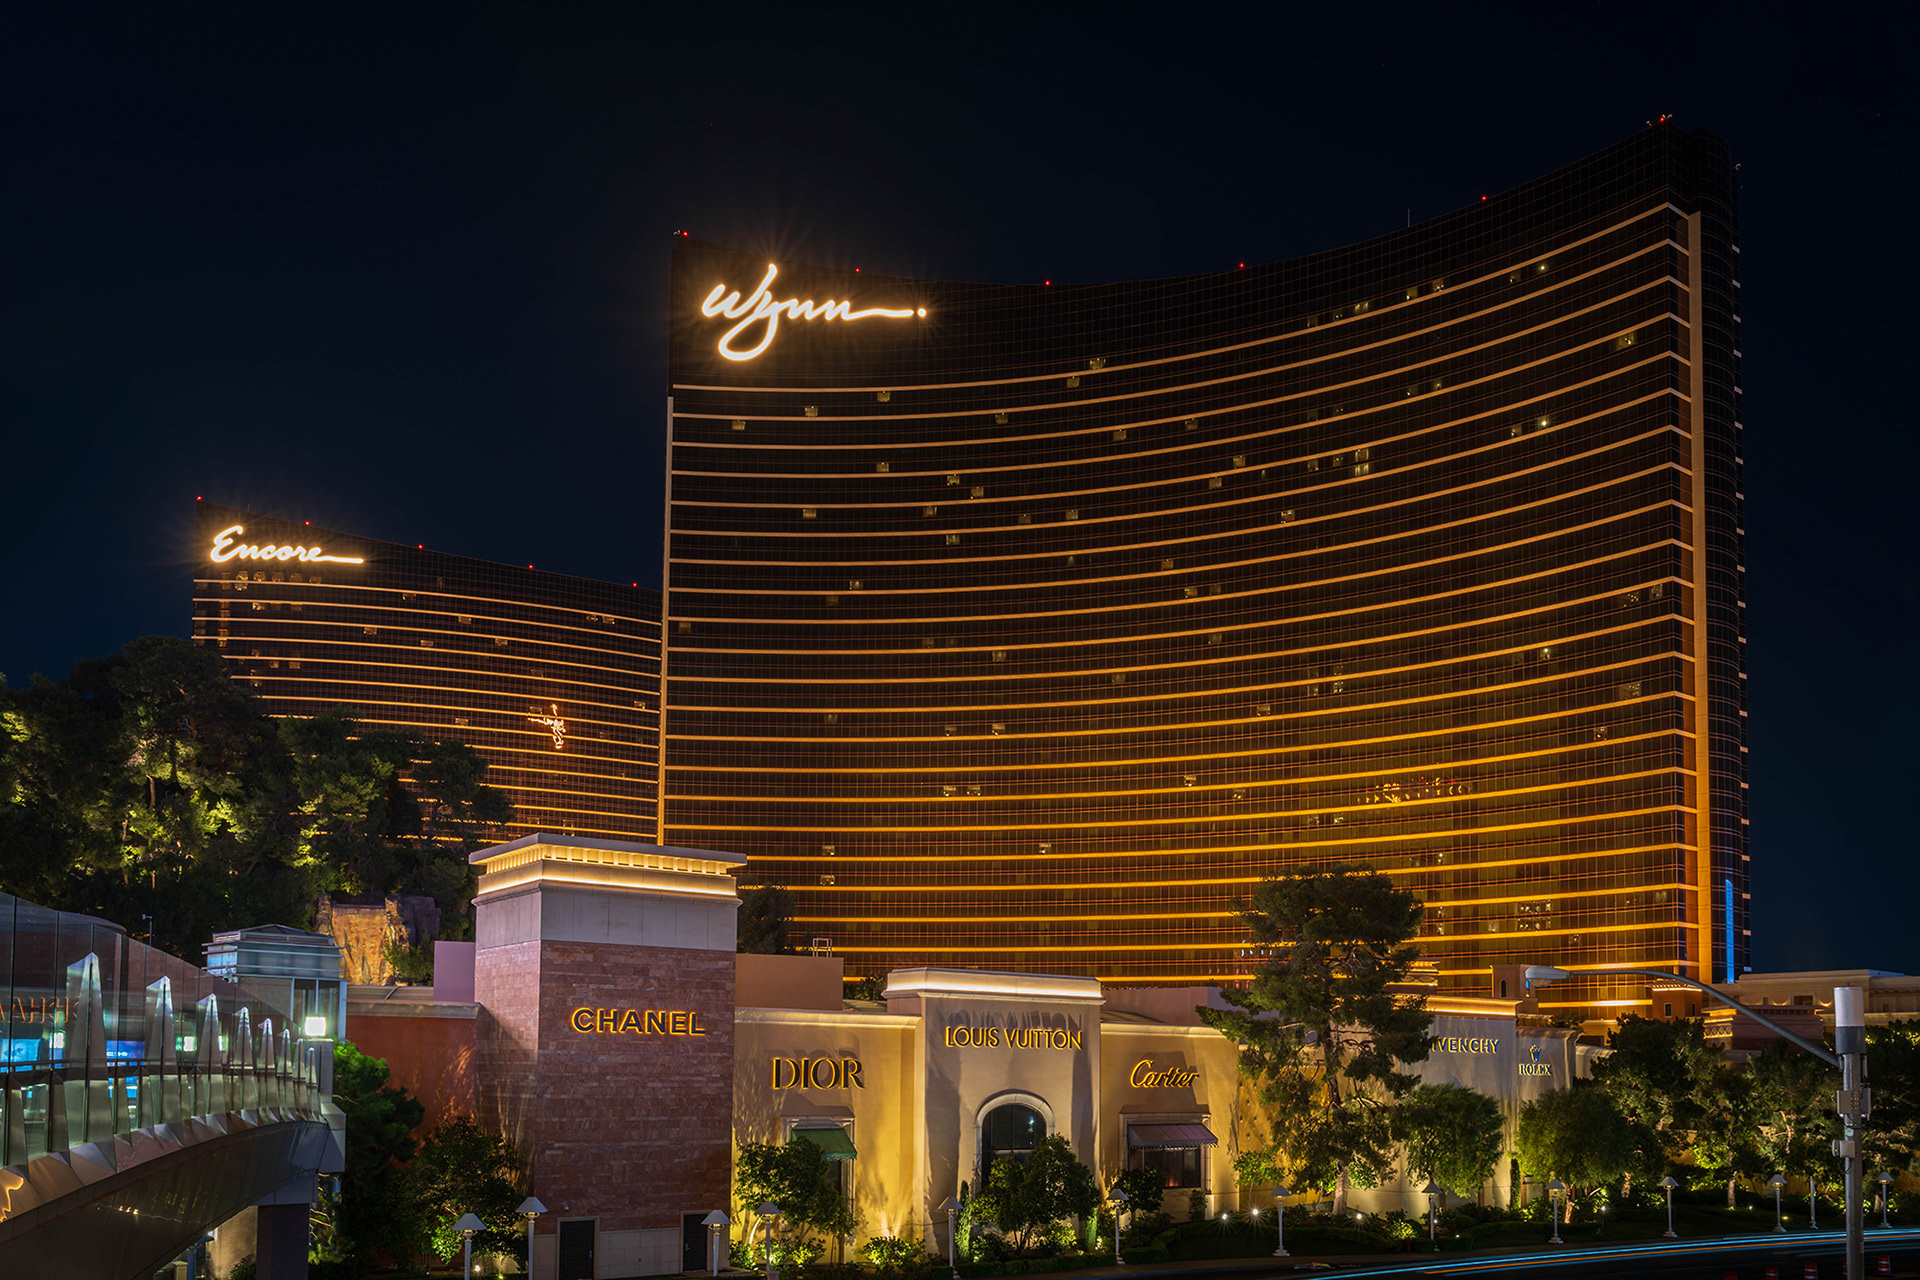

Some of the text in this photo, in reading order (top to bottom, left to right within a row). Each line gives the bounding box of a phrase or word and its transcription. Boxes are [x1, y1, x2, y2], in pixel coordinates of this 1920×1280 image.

[210, 525, 364, 563] Encore
[571, 1007, 706, 1036] CHANEL
[945, 1026, 1083, 1050] LOUIS VUITTON
[1421, 1036, 1500, 1054] IVENCHY
[771, 1057, 866, 1090] DIOR
[1130, 1059, 1200, 1088] Cartier
[1518, 1063, 1552, 1076] ROLEX
